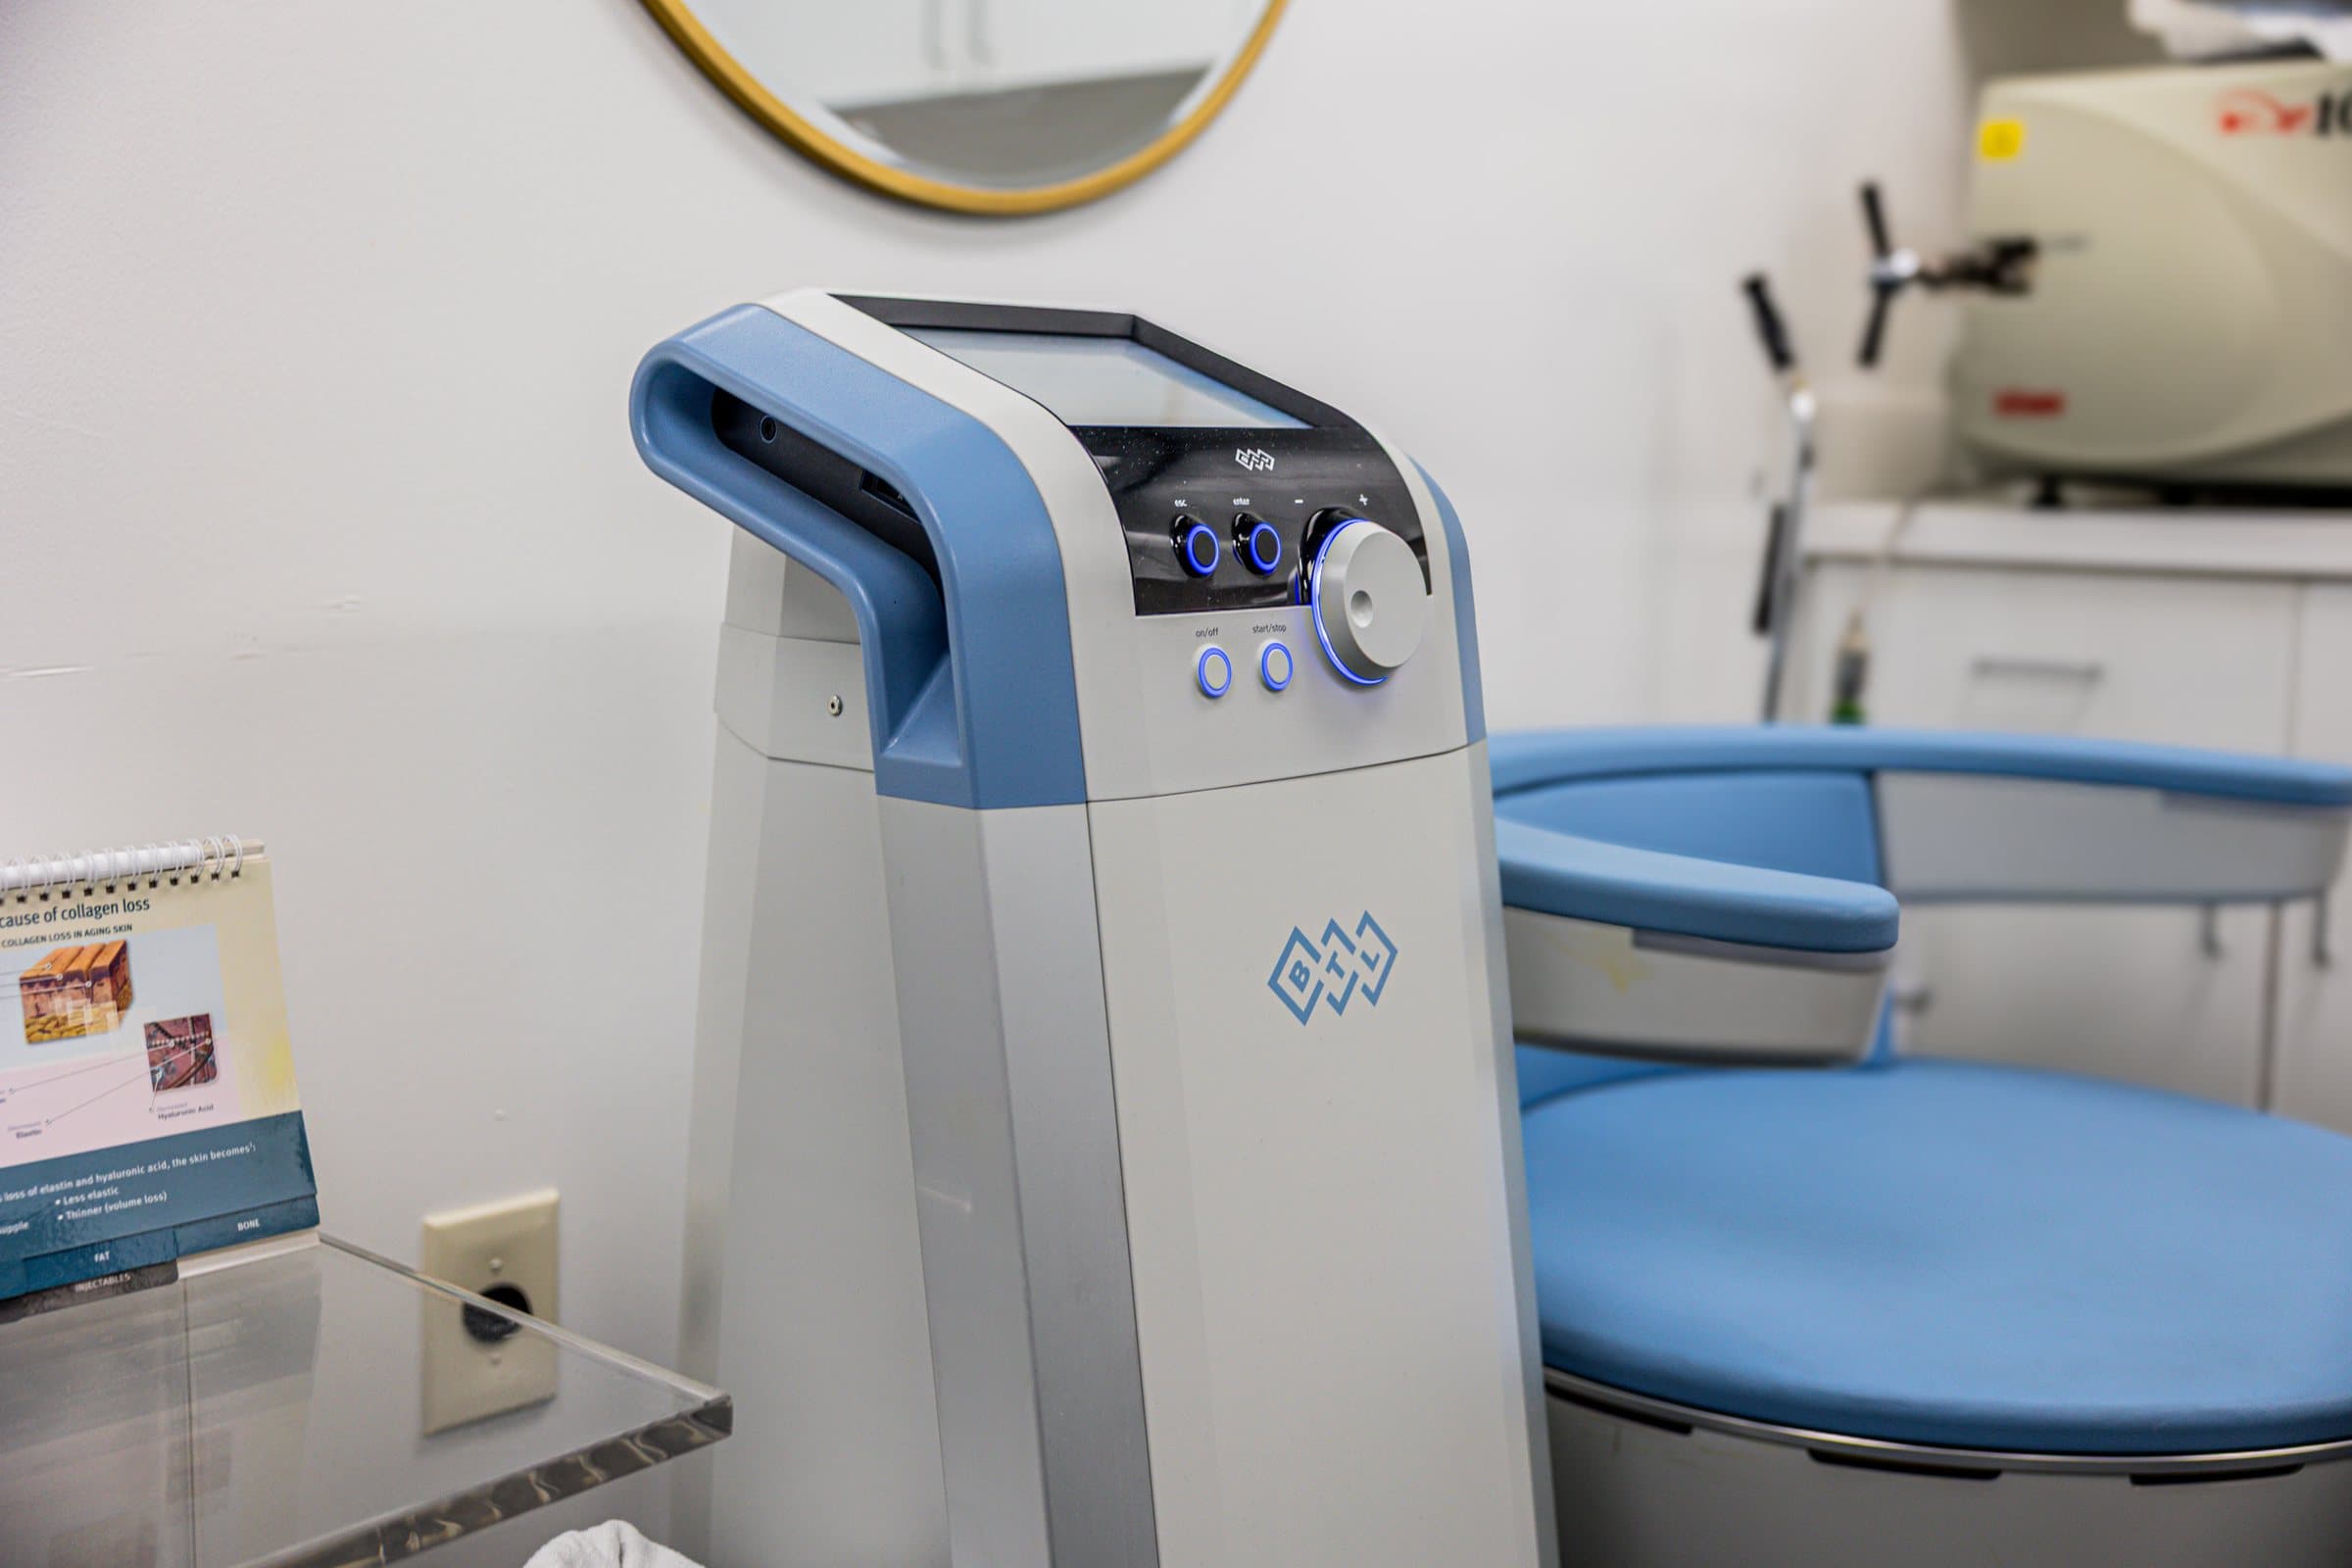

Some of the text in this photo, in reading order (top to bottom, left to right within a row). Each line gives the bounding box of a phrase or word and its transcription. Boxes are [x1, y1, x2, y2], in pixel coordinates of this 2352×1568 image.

[1196, 626, 1219, 638] on/off
[1252, 622, 1287, 634] start/stop
[0, 897, 150, 929] cause of collagen loss
[1, 923, 133, 948] COLLAGEN LOSS IN AGING SKIN
[4, 1190, 25, 1201] loss
[27, 1186, 38, 1197] of
[40, 1179, 74, 1195] elastin
[74, 1175, 94, 1188] and
[95, 1164, 145, 1184] hyaluronic
[147, 1160, 171, 1173] acid,
[172, 1156, 187, 1168] the
[189, 1152, 209, 1165] skin
[63, 1186, 119, 1206] Less elastic
[65, 1190, 168, 1220] Thinner (volume loss)
[237, 1218, 261, 1232] BONE
[94, 1250, 111, 1263] FAT
[74, 1273, 131, 1294] INJECTABLES
